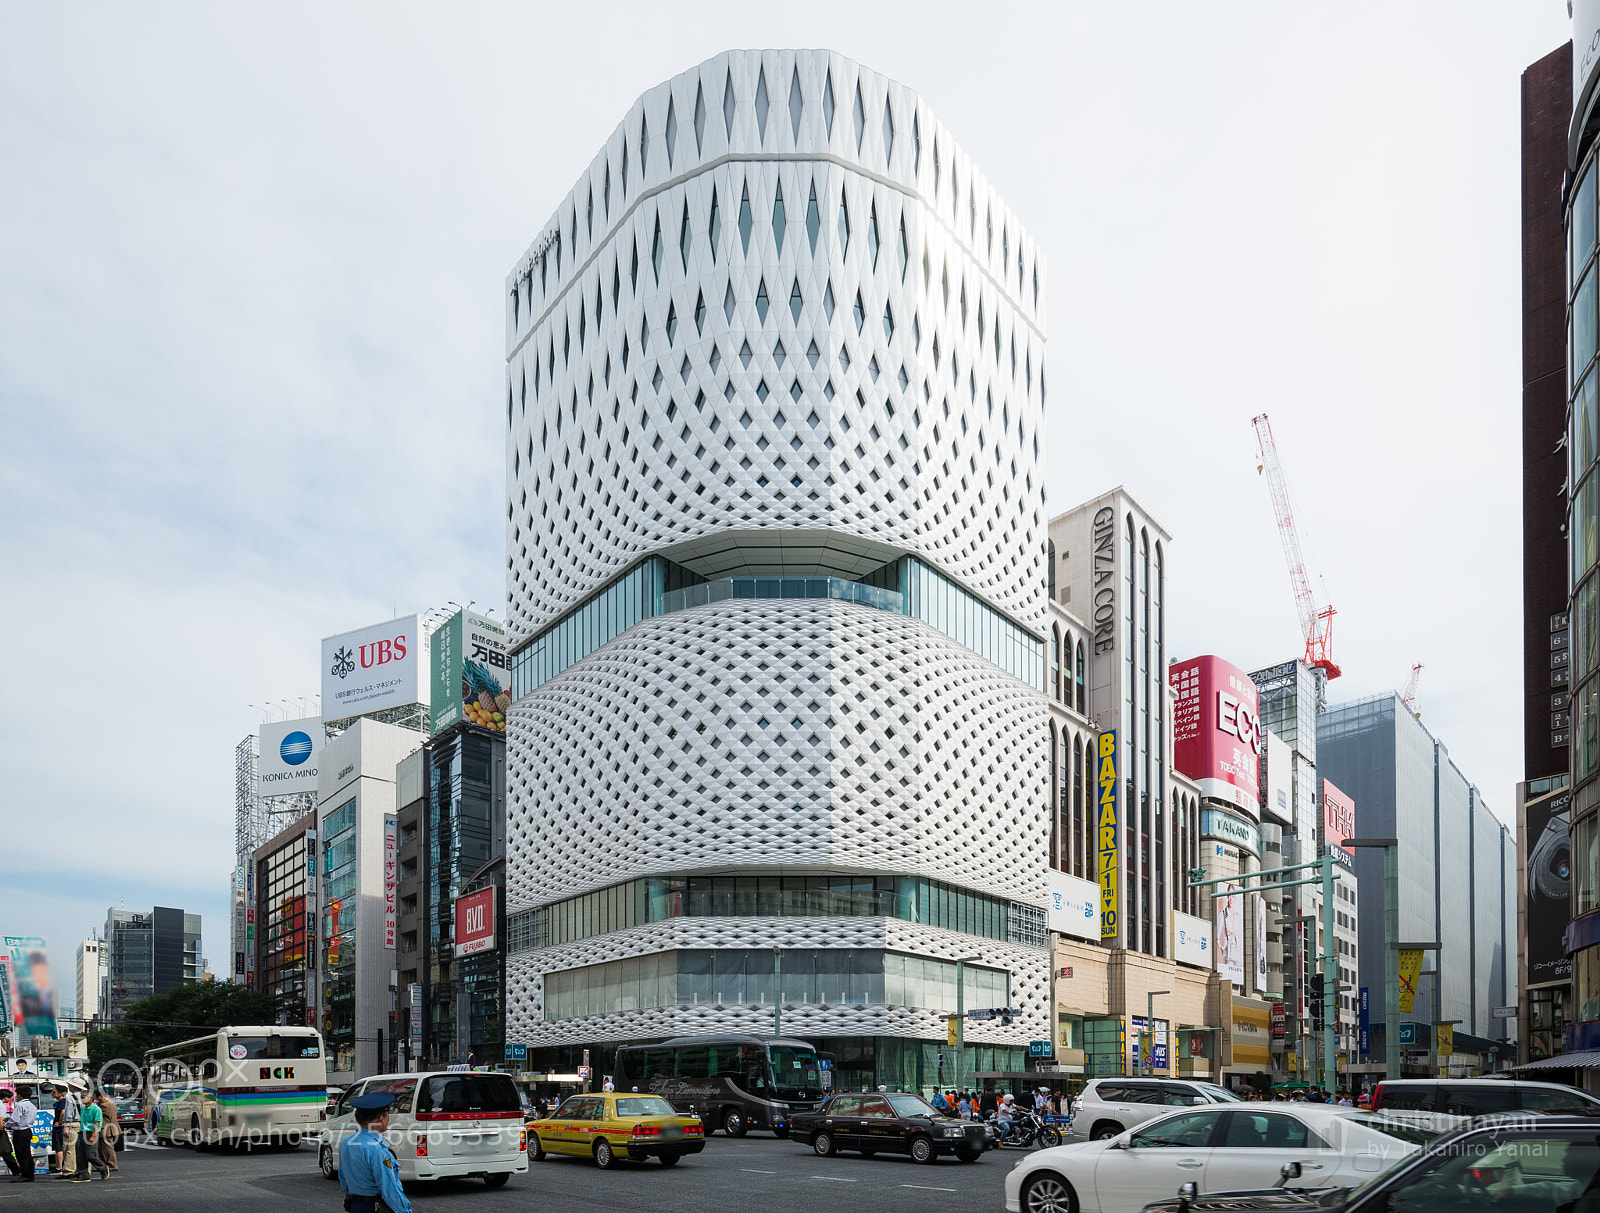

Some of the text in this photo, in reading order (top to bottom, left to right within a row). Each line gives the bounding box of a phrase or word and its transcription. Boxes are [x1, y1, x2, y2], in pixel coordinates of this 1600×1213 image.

[1093, 506, 1113, 656] GINZA CORE
[1554, 637, 1561, 645] 6
[359, 635, 407, 668] UBS
[1171, 666, 1200, 682] 英会話
[263, 768, 319, 783] KONICA MINO
[1099, 733, 1117, 850] BAZAR
[1325, 794, 1354, 840] THK
[1216, 819, 1249, 841] TAKANO
[1103, 888, 1114, 898] FRI
[1101, 910, 1117, 927] 10
[1101, 926, 1115, 936] SUN
[468, 940, 486, 952] FUJIBO
[39, 1060, 53, 1072] 拓
[260, 1067, 294, 1080] NCK
